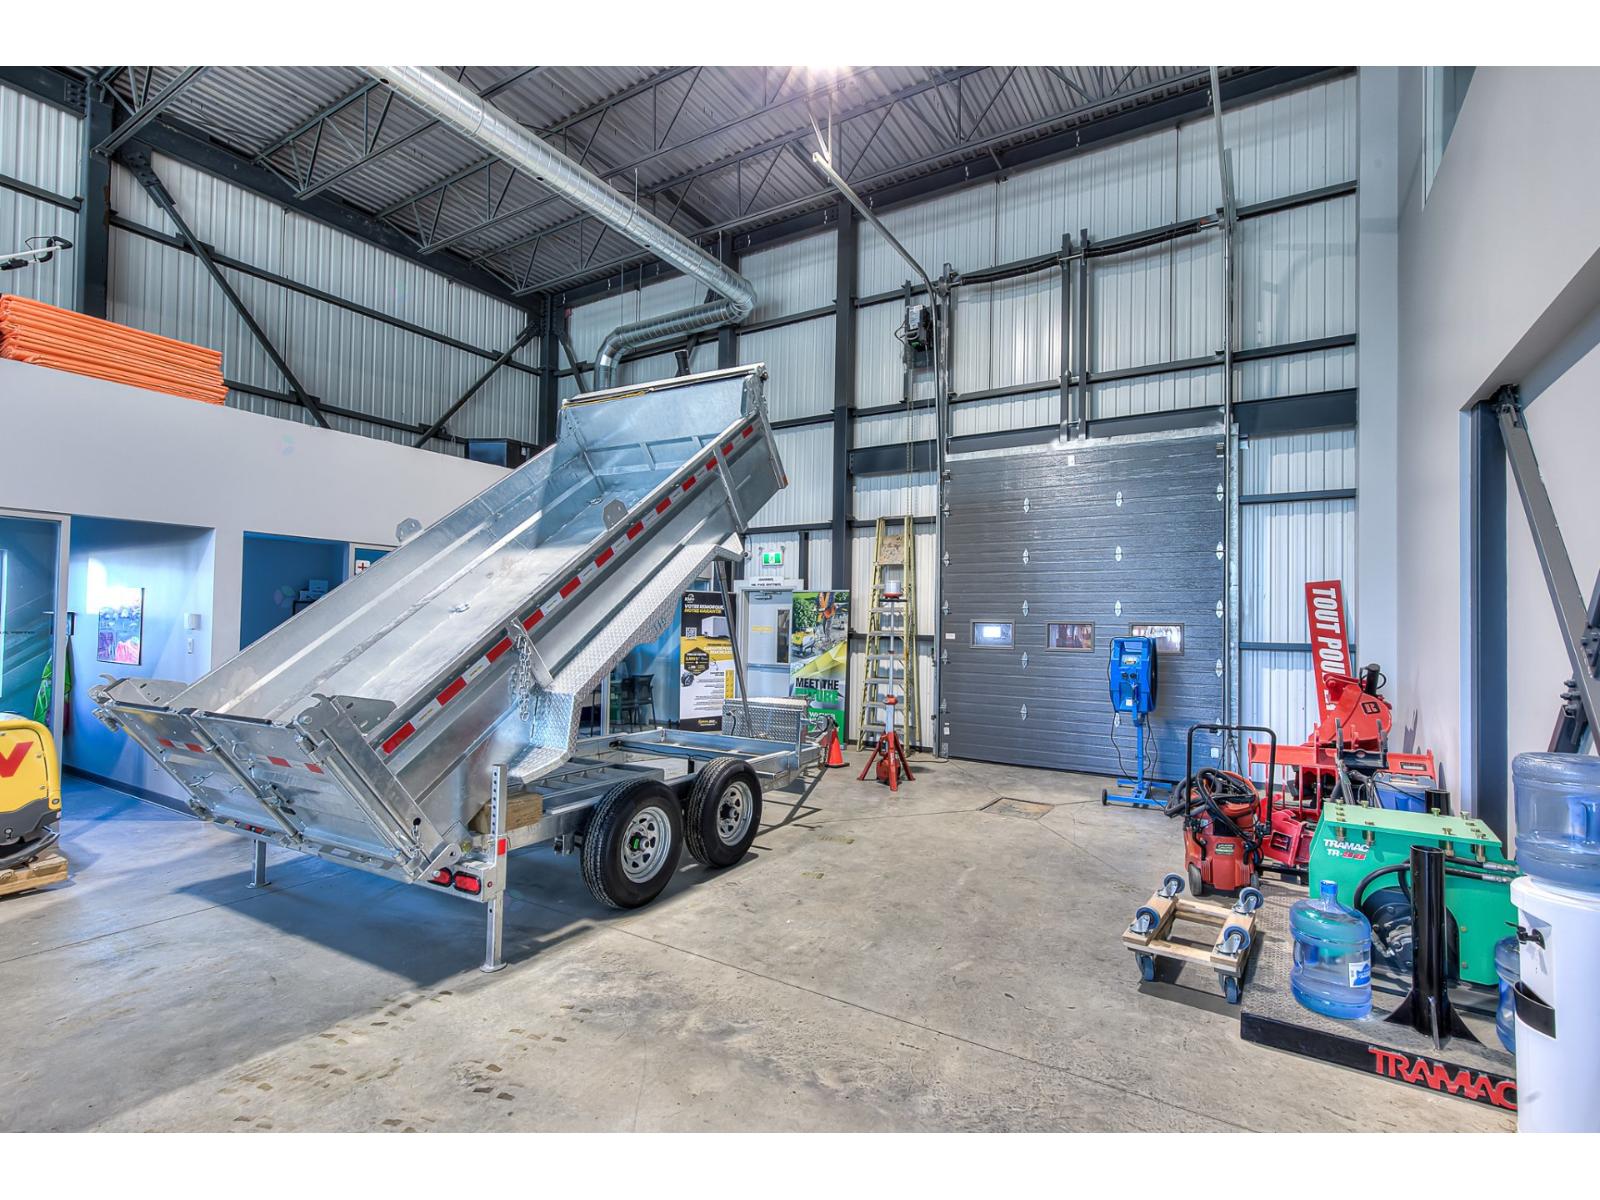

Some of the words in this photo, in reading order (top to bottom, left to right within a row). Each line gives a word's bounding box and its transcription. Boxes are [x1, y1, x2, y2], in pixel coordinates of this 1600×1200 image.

[1312, 587, 1341, 634] TOUT
[796, 677, 820, 690] MEET
[821, 679, 840, 690] THE
[1317, 636, 1346, 685] POU
[1323, 838, 1370, 853] TRAMAC
[1368, 1046, 1518, 1110] TRAMAC
